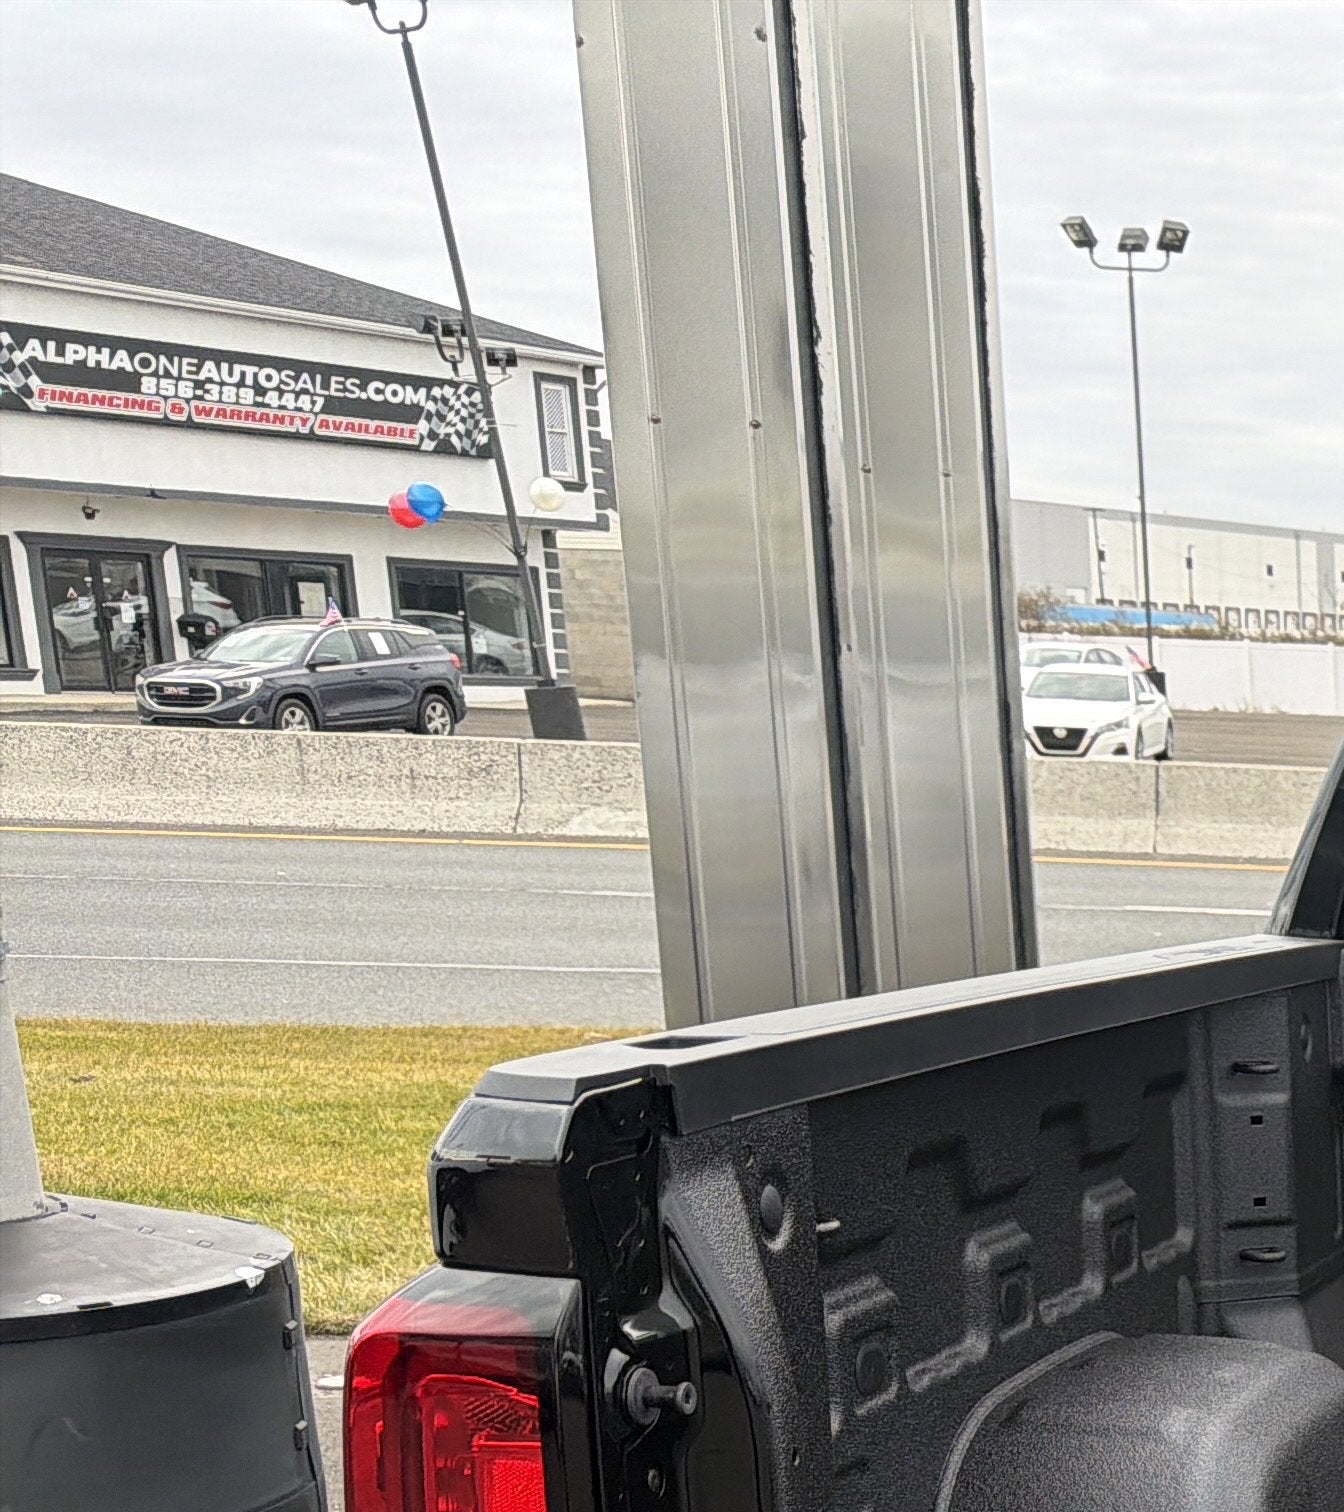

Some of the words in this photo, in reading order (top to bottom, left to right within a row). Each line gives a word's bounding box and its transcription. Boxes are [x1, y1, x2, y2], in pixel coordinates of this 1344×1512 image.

[20, 338, 427, 407] ALPHAONEAUTOSALES.COM
[140, 375, 325, 413] 856-389-4447
[37, 386, 163, 414] FINANCING
[169, 400, 187, 416] &
[193, 404, 311, 428] WARRANTY
[317, 418, 417, 440] AVAILABLE
